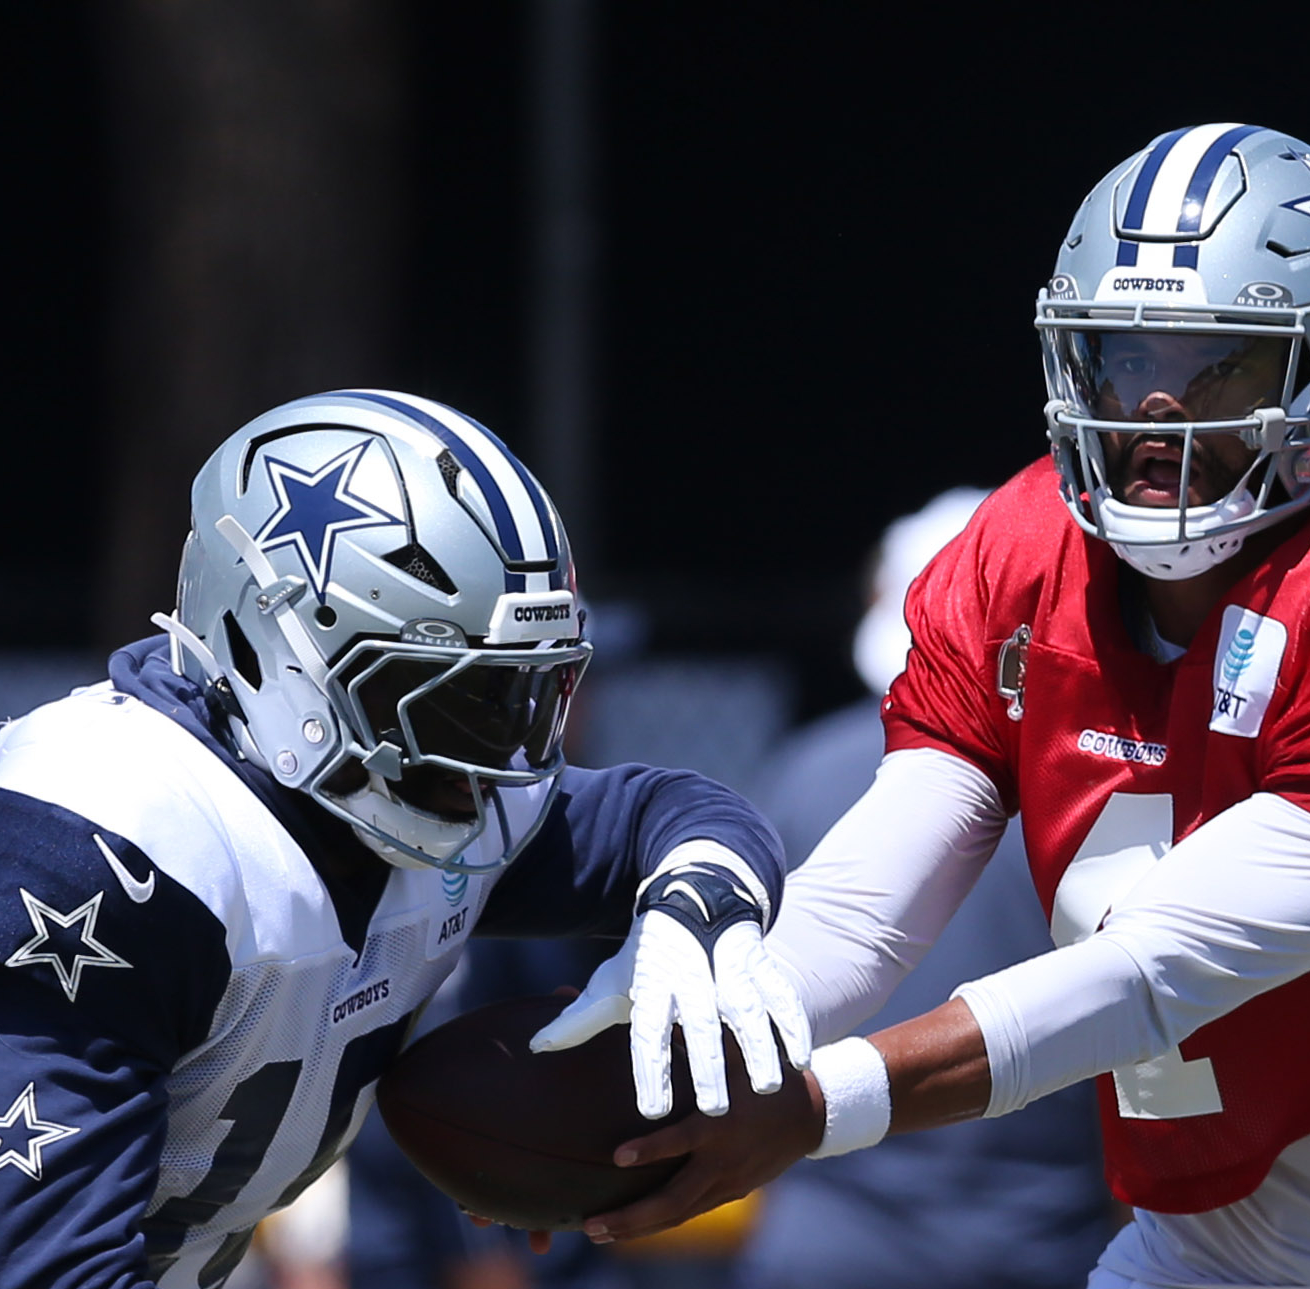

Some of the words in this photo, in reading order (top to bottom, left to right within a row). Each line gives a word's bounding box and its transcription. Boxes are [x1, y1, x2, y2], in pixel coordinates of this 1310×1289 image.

[1113, 277, 1185, 293] COWBOYS
[1236, 296, 1290, 309] OAKLEY
[514, 603, 571, 622] COWBOYS
[403, 632, 463, 647] OAKLEY
[1212, 687, 1248, 719] T&T
[437, 906, 469, 945] AT&T
[332, 979, 390, 1024] COWBOYS
